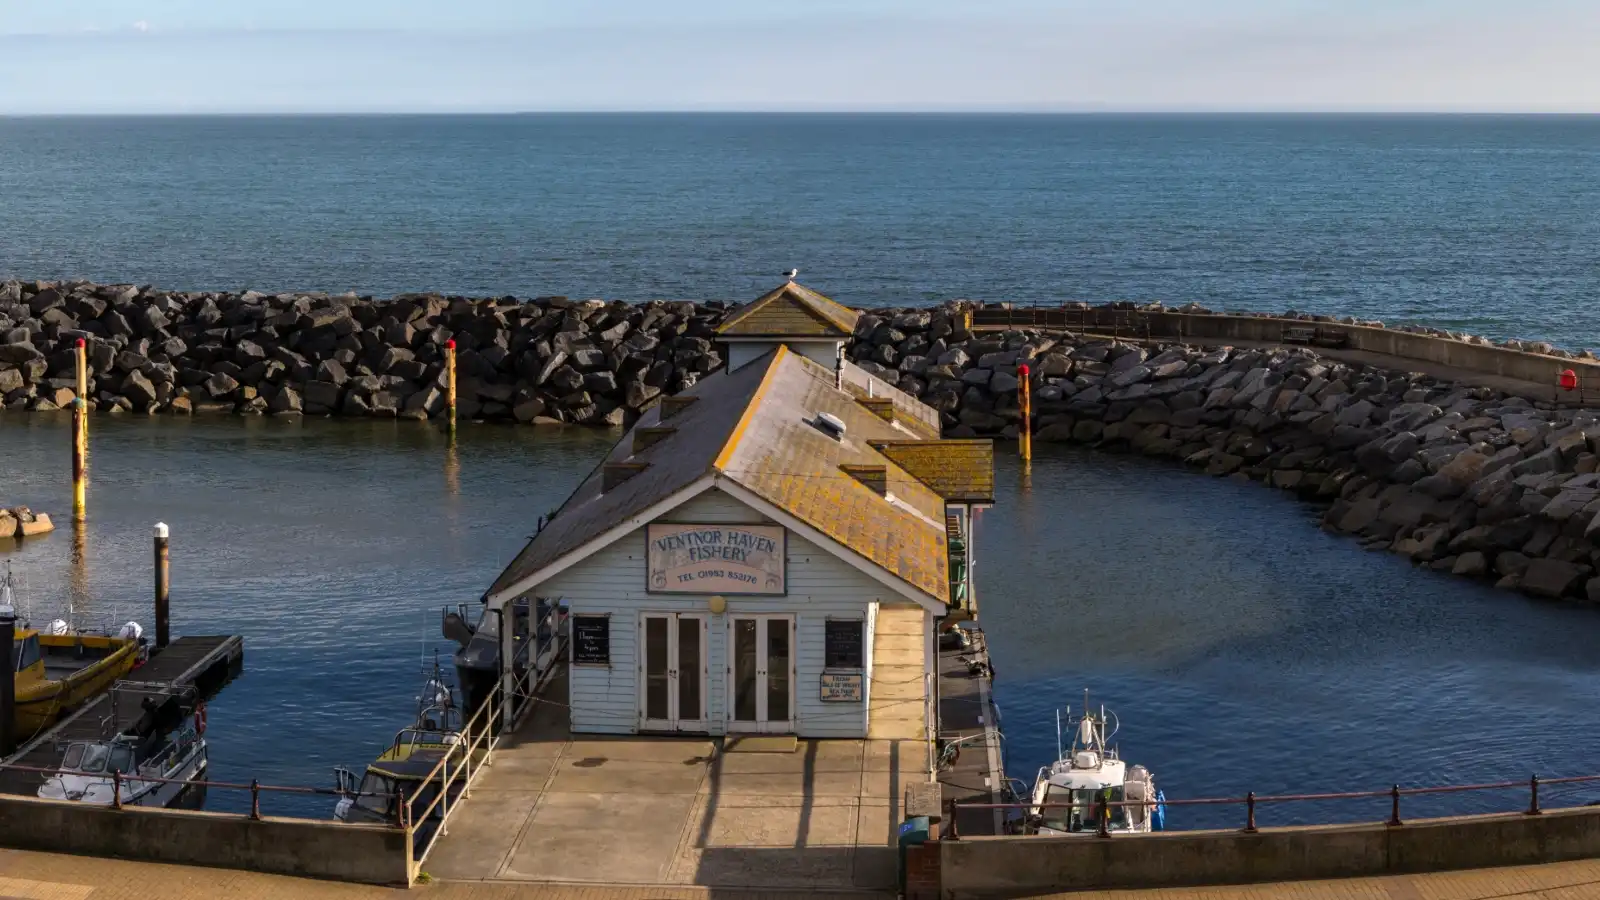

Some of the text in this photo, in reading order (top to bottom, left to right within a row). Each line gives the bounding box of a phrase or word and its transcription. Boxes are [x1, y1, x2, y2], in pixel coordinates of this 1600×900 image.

[657, 530, 776, 552] VENTNOR HAVEN
[689, 545, 751, 561] FISHERY
[698, 570, 724, 579] 01983
